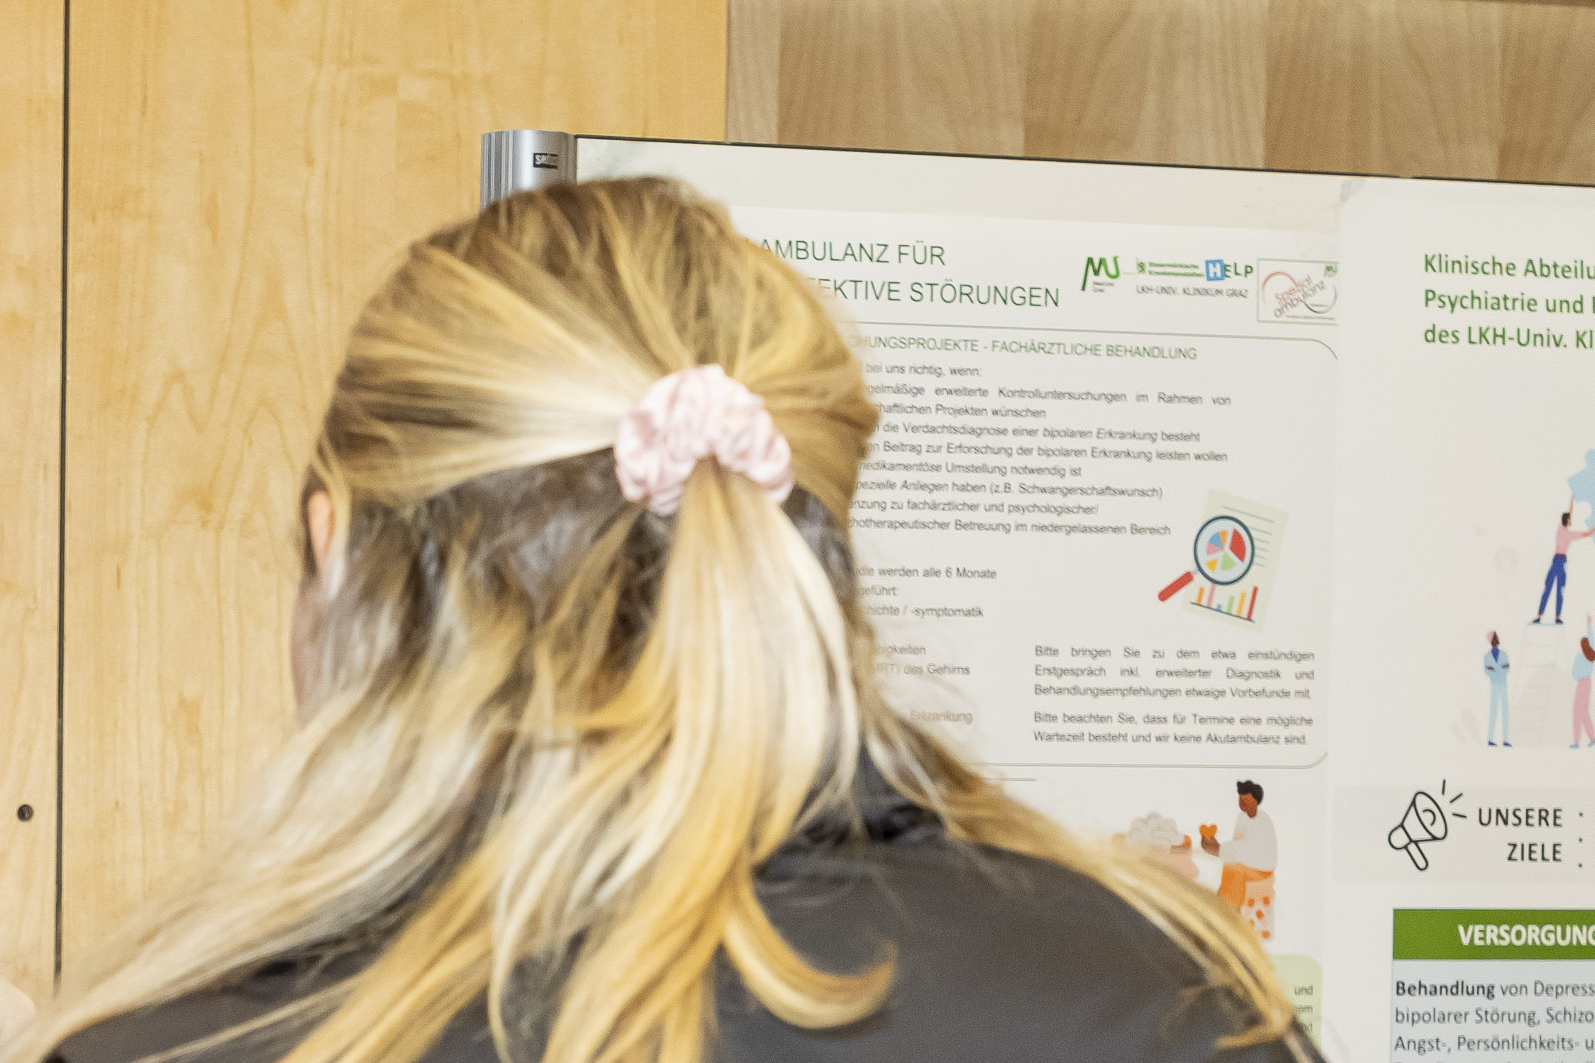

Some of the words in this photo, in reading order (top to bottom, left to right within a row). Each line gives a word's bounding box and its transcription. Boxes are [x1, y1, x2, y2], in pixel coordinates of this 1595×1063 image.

[758, 238, 889, 263] AMBULANZ
[897, 239, 946, 265] FÜR
[1424, 253, 1517, 276] Klinische
[909, 278, 1059, 307] STÖRUNGEN
[1424, 289, 1538, 313] Psychiatrie
[1545, 294, 1584, 313] und
[1423, 323, 1460, 344] des
[1467, 326, 1568, 347] LKH-Univ.
[1575, 329, 1595, 349] Kl
[992, 338, 1102, 357] FACHÄRZTLICHE
[1106, 344, 1197, 360] BEHANDLUNG
[885, 365, 906, 375] uns
[866, 383, 925, 398] gelmäßige
[934, 386, 989, 398] erweiterte
[998, 387, 1126, 404] Kontrolluntersuchungen
[1136, 391, 1149, 402] im
[1158, 391, 1203, 404] Rahmen
[1212, 396, 1231, 405] von
[935, 403, 988, 418] Projekten
[992, 405, 1046, 418] wünschen
[883, 422, 899, 433] die
[903, 422, 1008, 438] Verdachtsdiagnose
[1012, 425, 1038, 437] einer
[1042, 427, 1093, 440] bipolaren
[1096, 427, 1158, 443] Erkrankung
[1161, 430, 1201, 442] besteht
[883, 441, 922, 455] Beitrag
[926, 444, 943, 453] zur
[947, 441, 1013, 458] Erforschung
[1016, 444, 1033, 456] der
[1037, 446, 1088, 459] bipolaren
[1091, 446, 1153, 463] Erkrankung
[1156, 449, 1191, 461] leisten
[1194, 451, 1228, 462] wollen
[945, 461, 1008, 477] Umstellung
[1011, 465, 1066, 479] notwendig
[1069, 465, 1082, 477] ist
[856, 480, 896, 492] pezielle
[900, 480, 949, 494] Anliegen
[952, 481, 986, 493] haben
[1018, 482, 1164, 500] Schwangerschaftswunsch)
[890, 501, 904, 510] zu
[907, 499, 980, 512] fachärztlicher
[984, 501, 1004, 513] und
[954, 519, 1011, 534] Betreuung
[1014, 521, 1027, 532] im
[1031, 522, 1126, 536] niedergelassenen
[1130, 523, 1171, 536] Bereich
[878, 566, 919, 577] werden
[922, 566, 942, 578] alle
[945, 567, 953, 578] 6
[956, 567, 997, 579] Monate
[866, 604, 900, 617] hichte
[1035, 644, 1059, 658] Bitte
[1071, 645, 1111, 661] bringen
[1123, 646, 1141, 659] Sie
[1152, 649, 1165, 659] zu
[1176, 647, 1200, 660] dem
[1211, 649, 1237, 661] etwa
[1248, 648, 1315, 663] einstündigen
[1034, 664, 1106, 680] Erstgespräch
[1155, 666, 1212, 679] erweiterter
[1226, 667, 1282, 682] Diagnostik
[1294, 668, 1315, 681] und
[1034, 683, 1182, 700] Behandlungsempfehlungen
[1185, 686, 1227, 701] etwaige
[1230, 686, 1291, 700] Vorbefunde
[1034, 711, 1058, 724] Bitte
[1063, 711, 1113, 724] beachten
[1143, 712, 1168, 725] dass
[1173, 712, 1187, 725] für
[1191, 713, 1235, 726] Termine
[1239, 715, 1262, 726] eine
[1266, 714, 1314, 728] mögliche
[1034, 730, 1085, 743] Wartezeit
[1088, 731, 1128, 744] besteht
[1132, 731, 1151, 744] und
[1154, 732, 1171, 744] wir
[1173, 732, 1202, 745] keine
[1205, 732, 1281, 745] Akutambulanz
[1478, 807, 1564, 828] UNSERE
[1507, 842, 1563, 863] ZIELE
[1395, 980, 1495, 1001] Behandlung
[1500, 984, 1528, 997] von
[1533, 979, 1595, 1000] Depress
[1395, 1006, 1470, 1027] bipolarer
[1474, 1006, 1541, 1028] Störung,
[1545, 1006, 1595, 1024] Schizo
[1394, 1036, 1452, 1056] Angst-,
[1456, 1034, 1581, 1052] Persönlichkeits-
